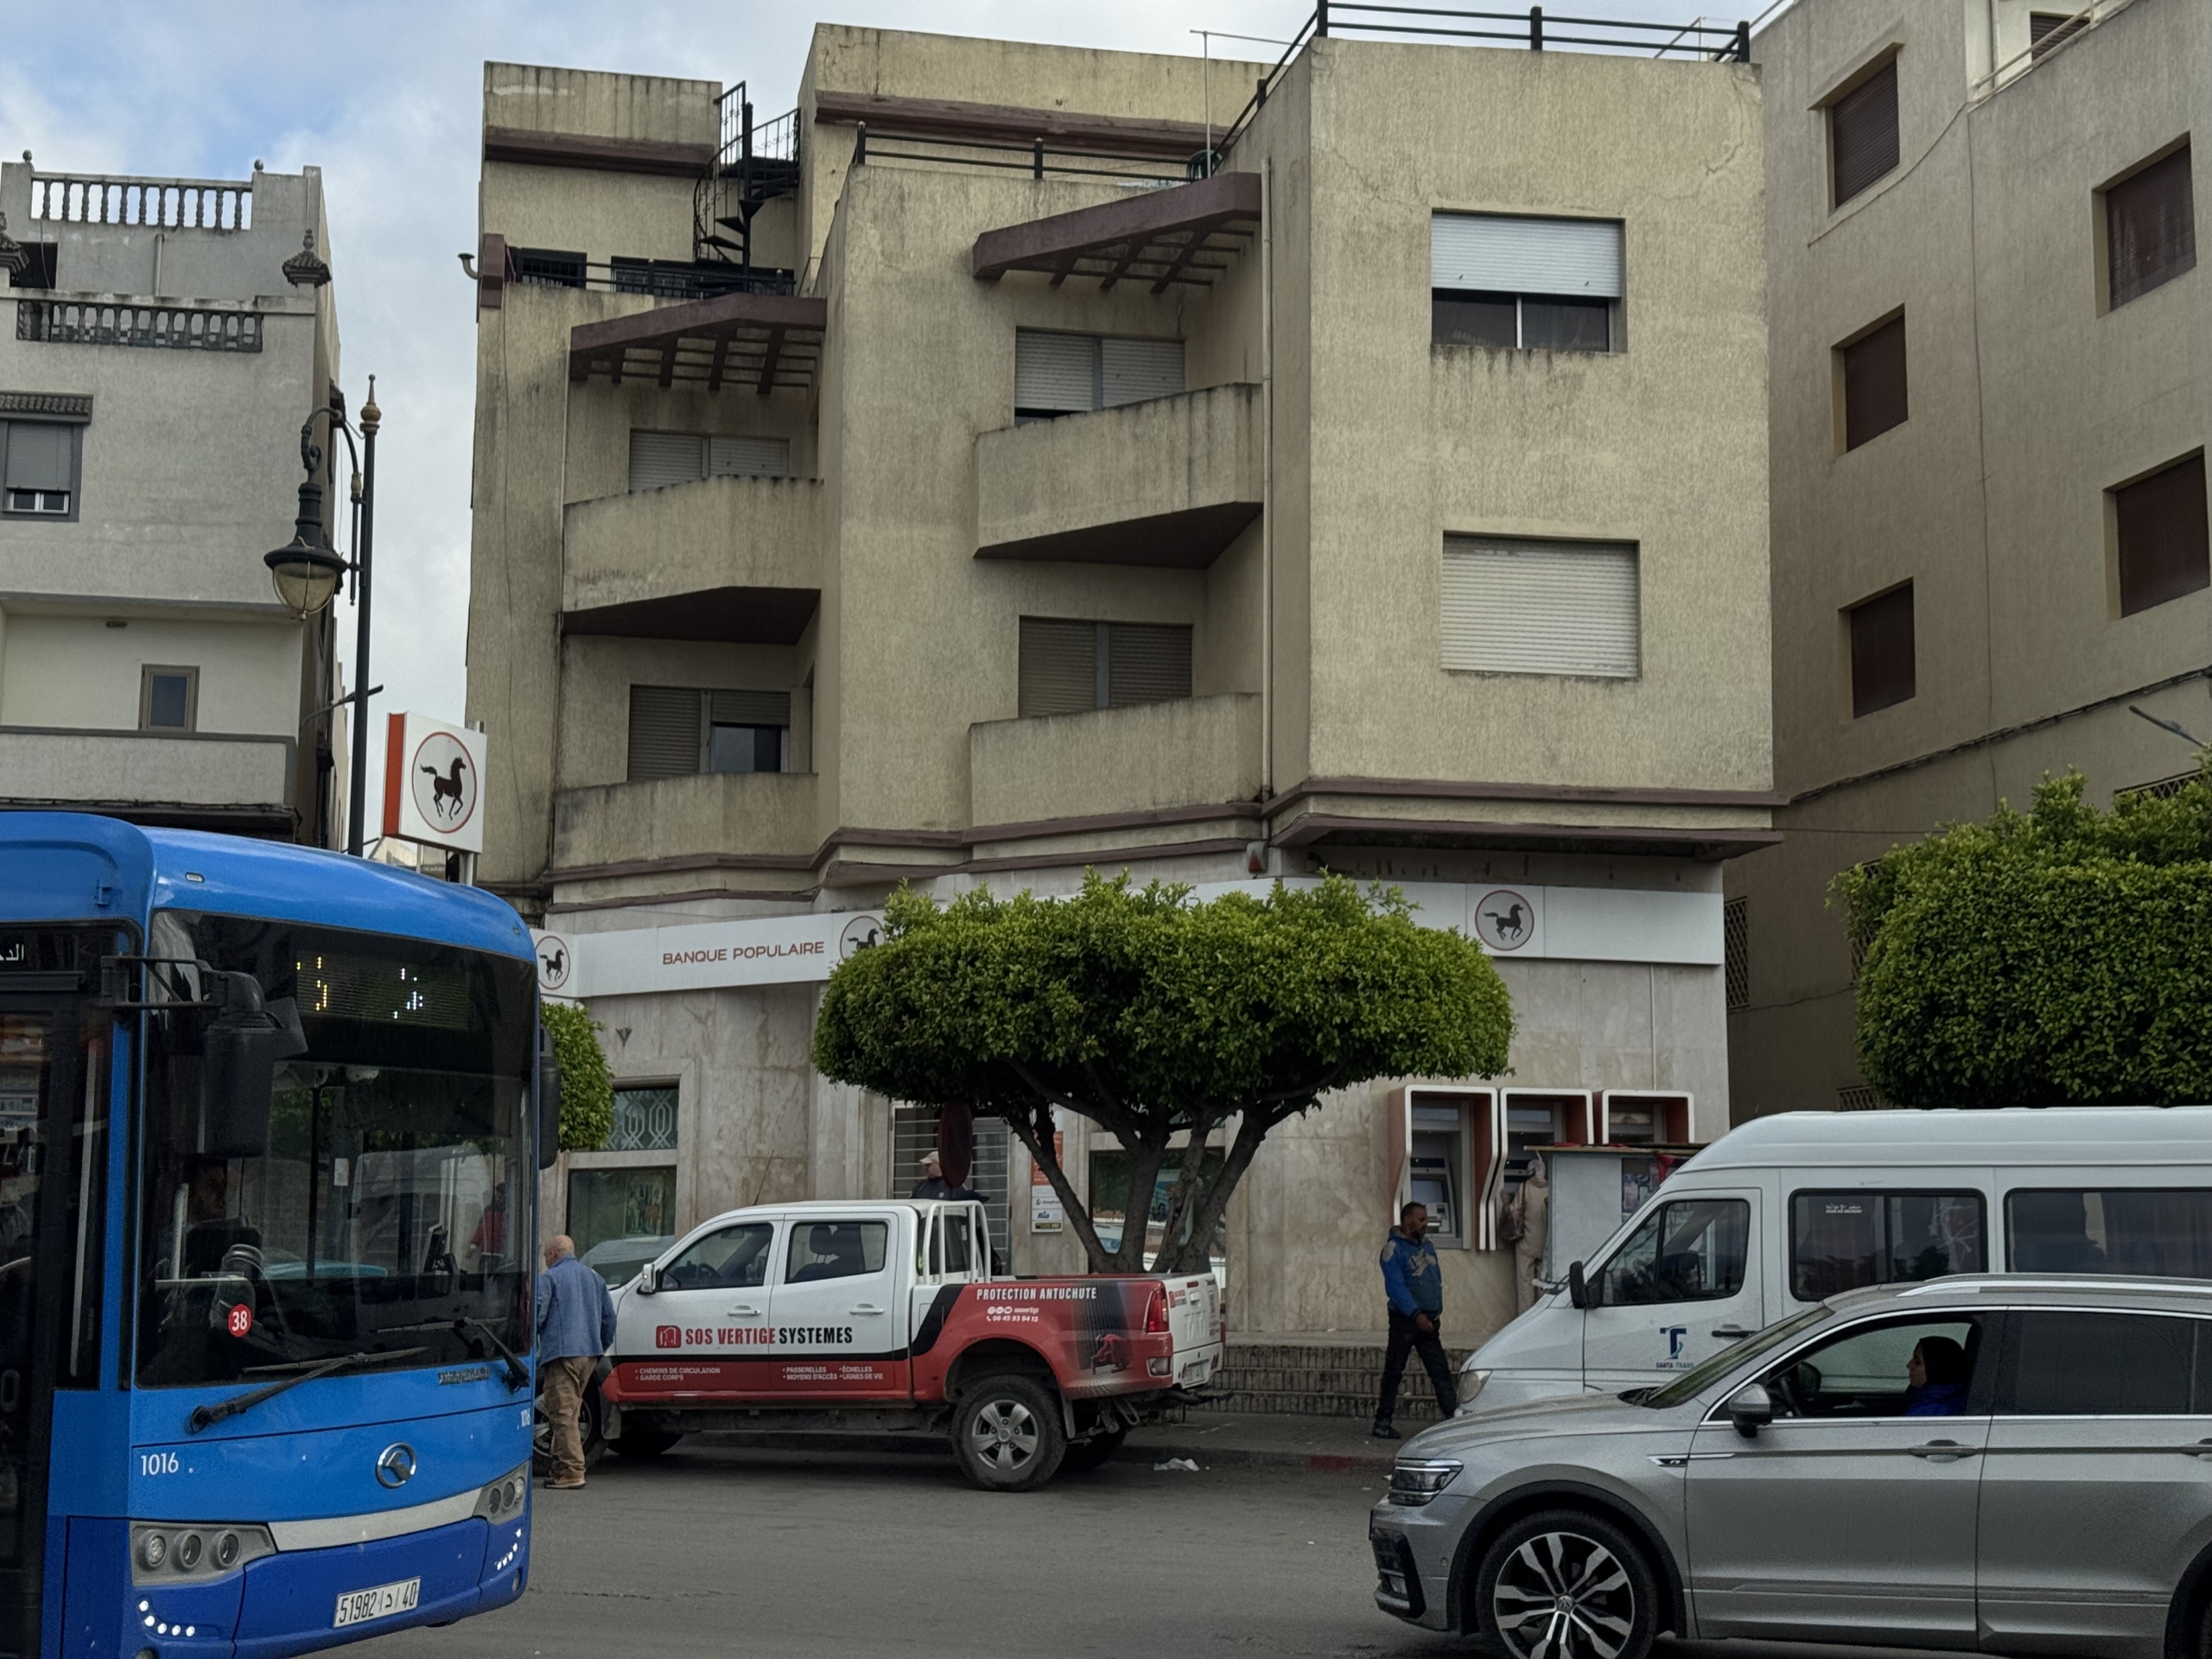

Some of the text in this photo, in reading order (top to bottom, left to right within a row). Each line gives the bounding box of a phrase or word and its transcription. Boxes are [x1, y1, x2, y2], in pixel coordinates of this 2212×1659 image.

[662, 941, 825, 965] BANQUE POPULAIRE
[976, 1287, 1097, 1300] PROTECTION ANTUCHUTE
[232, 1310, 248, 1332] 38
[685, 1326, 853, 1345] SOS VERTIGE SYSTEMES
[140, 1452, 180, 1477] 1016
[339, 1591, 378, 1624] 51982
[403, 1581, 417, 1608] 40
